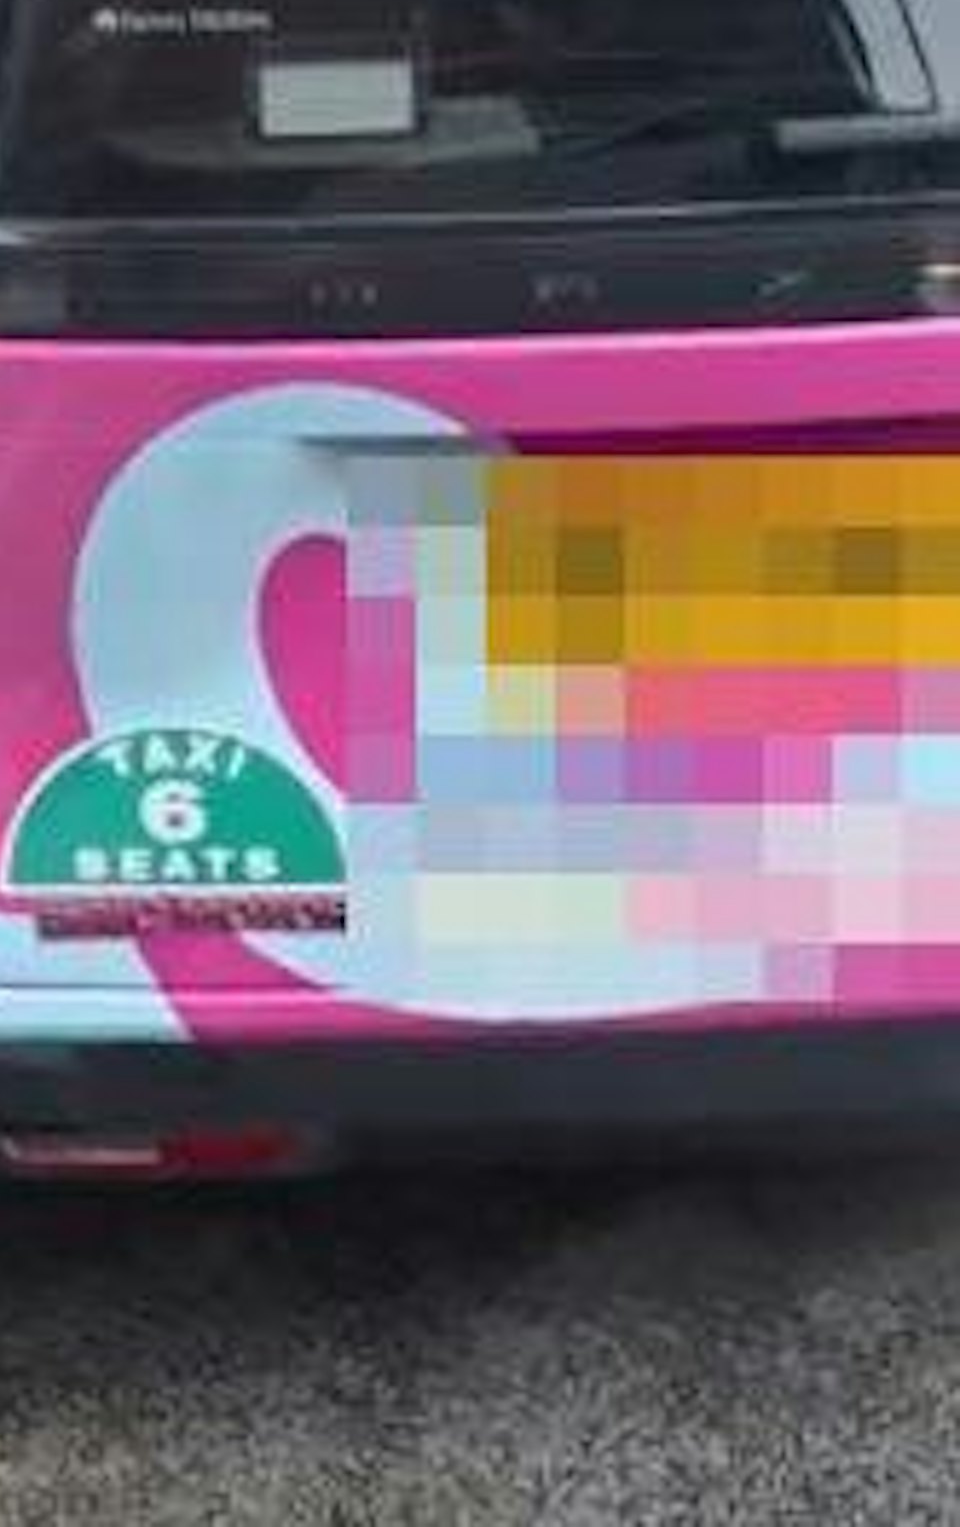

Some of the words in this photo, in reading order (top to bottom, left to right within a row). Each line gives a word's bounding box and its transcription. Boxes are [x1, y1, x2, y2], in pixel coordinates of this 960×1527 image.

[95, 733, 248, 780] TAXI
[139, 778, 208, 844] 6
[72, 845, 280, 880] SEATS
